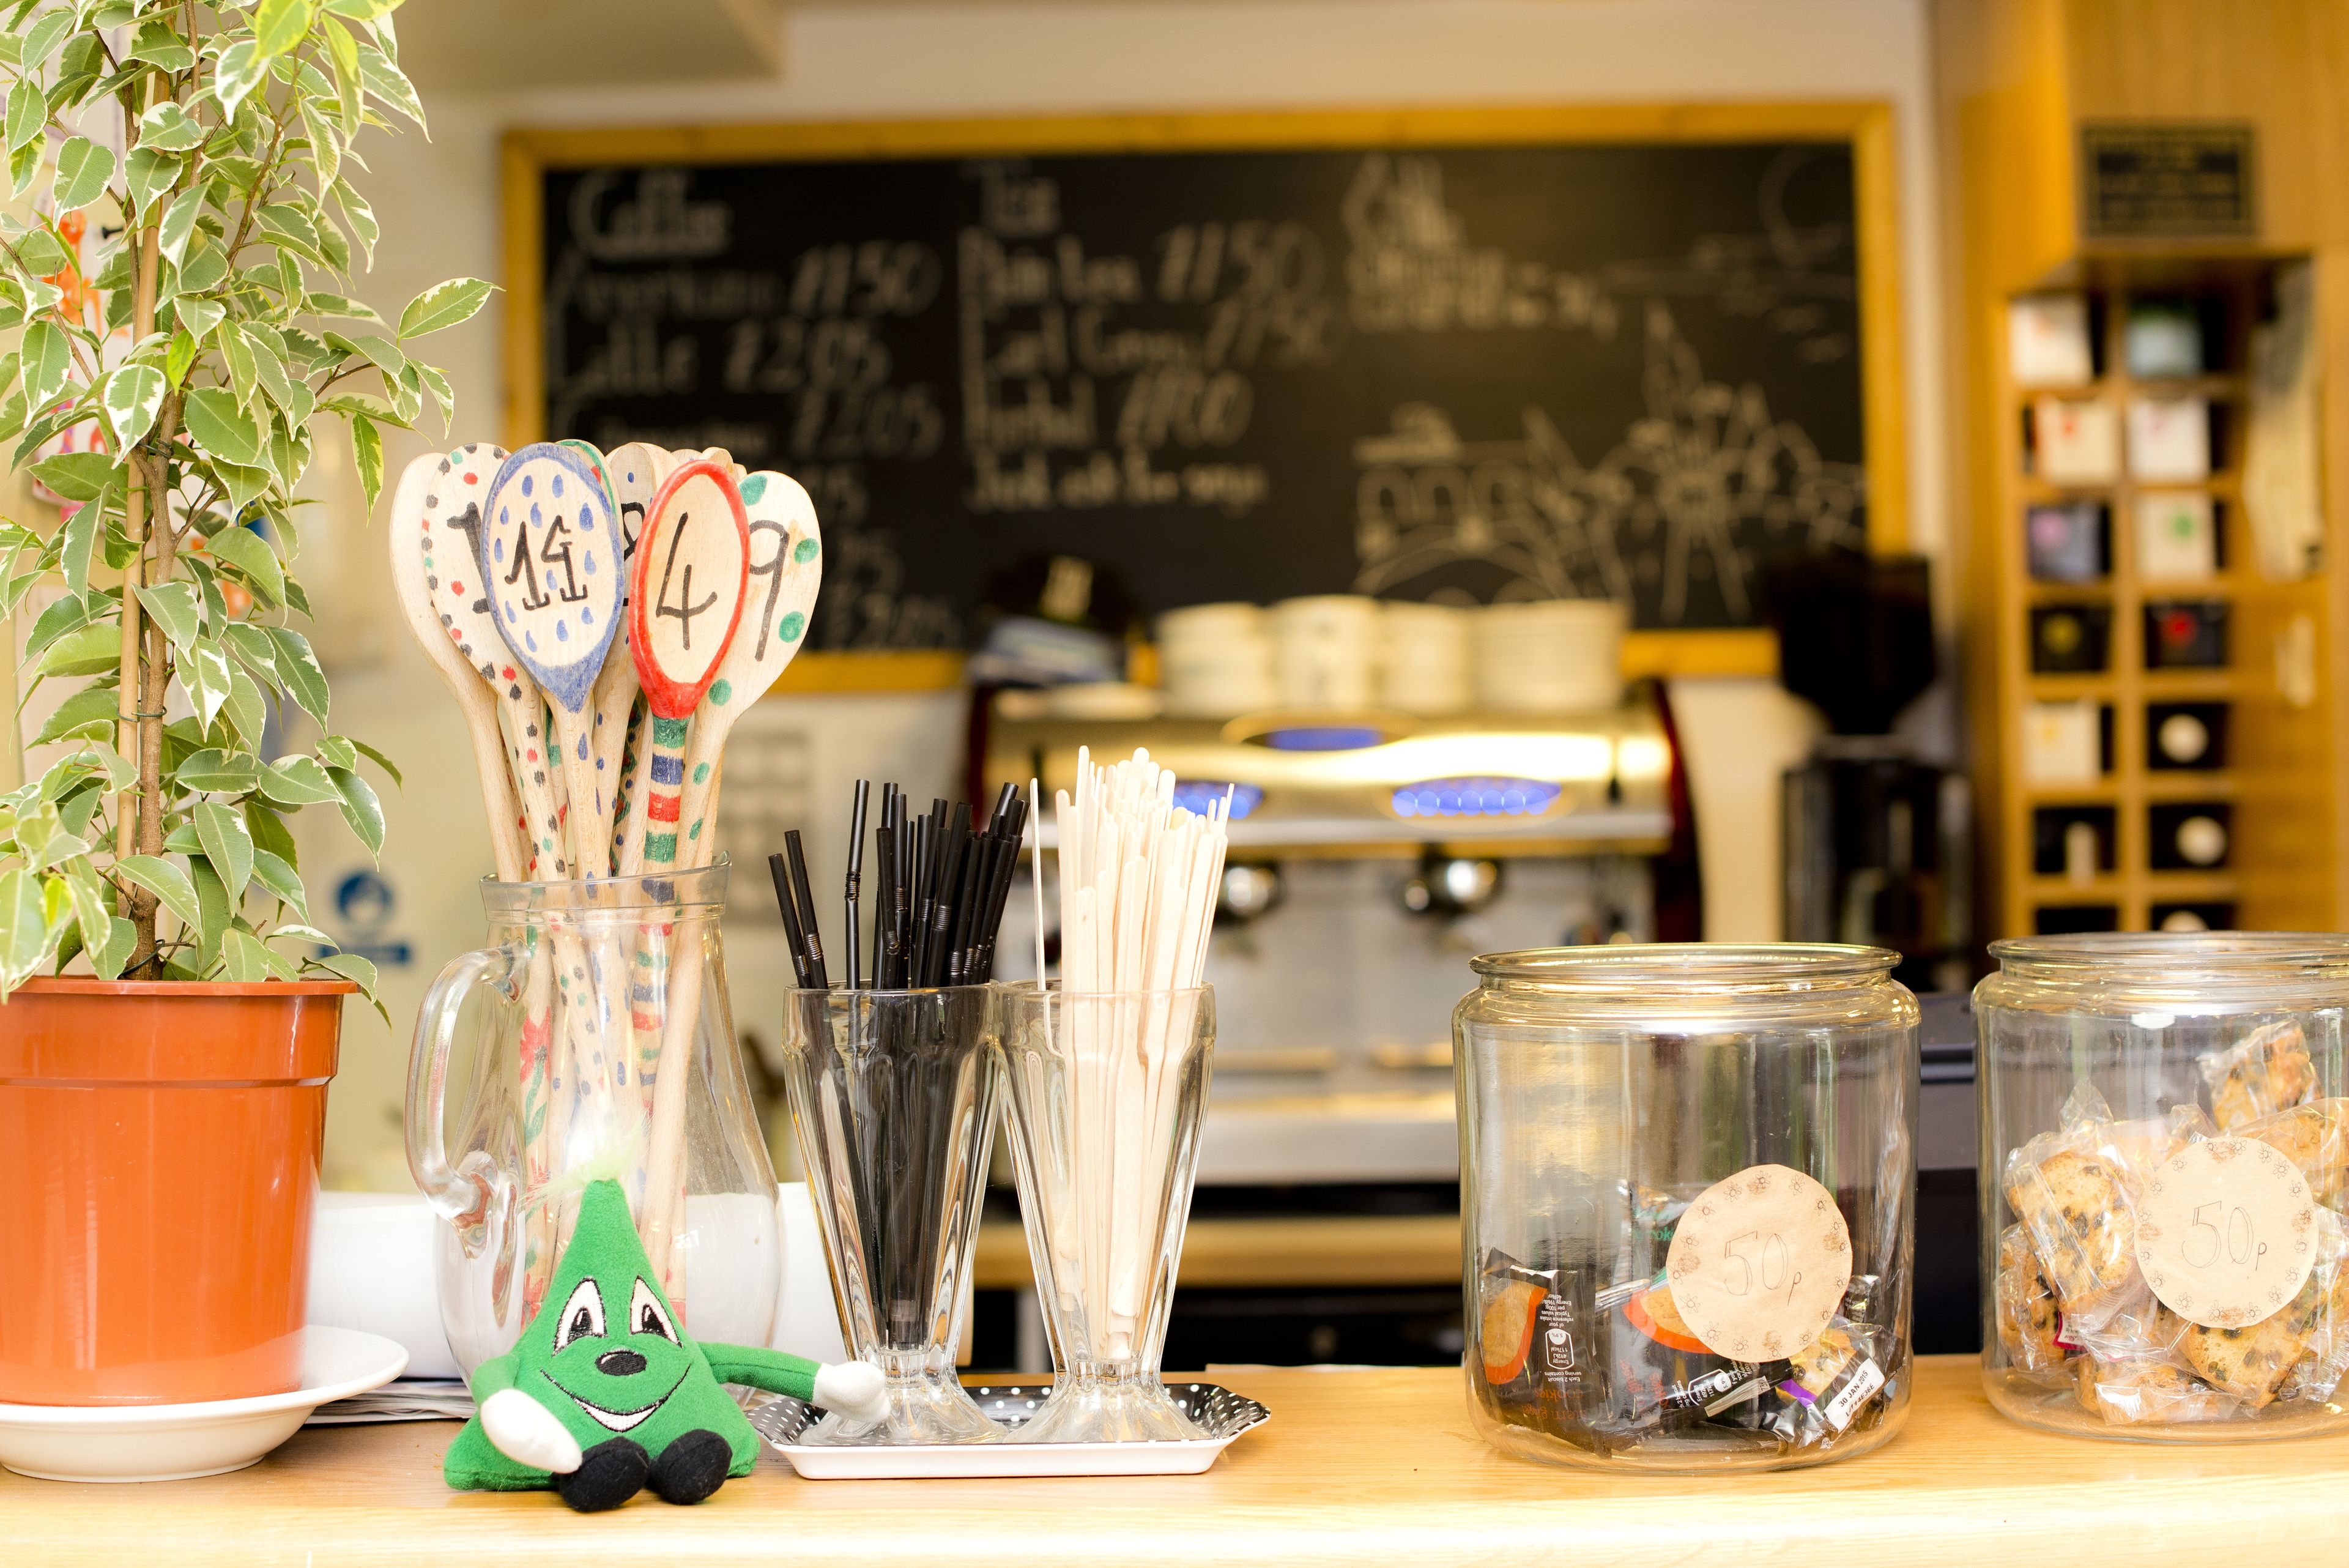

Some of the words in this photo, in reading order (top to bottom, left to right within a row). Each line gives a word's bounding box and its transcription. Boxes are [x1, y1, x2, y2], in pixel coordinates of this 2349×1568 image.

[656, 512, 718, 650] 4
[749, 519, 790, 662] 9
[1724, 1230, 1802, 1307] 50p
[2181, 1200, 2268, 1271] 50p
[1838, 1399, 1849, 1408] 30
[1849, 1383, 1860, 1399] JAN
[1859, 1370, 1869, 1386] 2015
